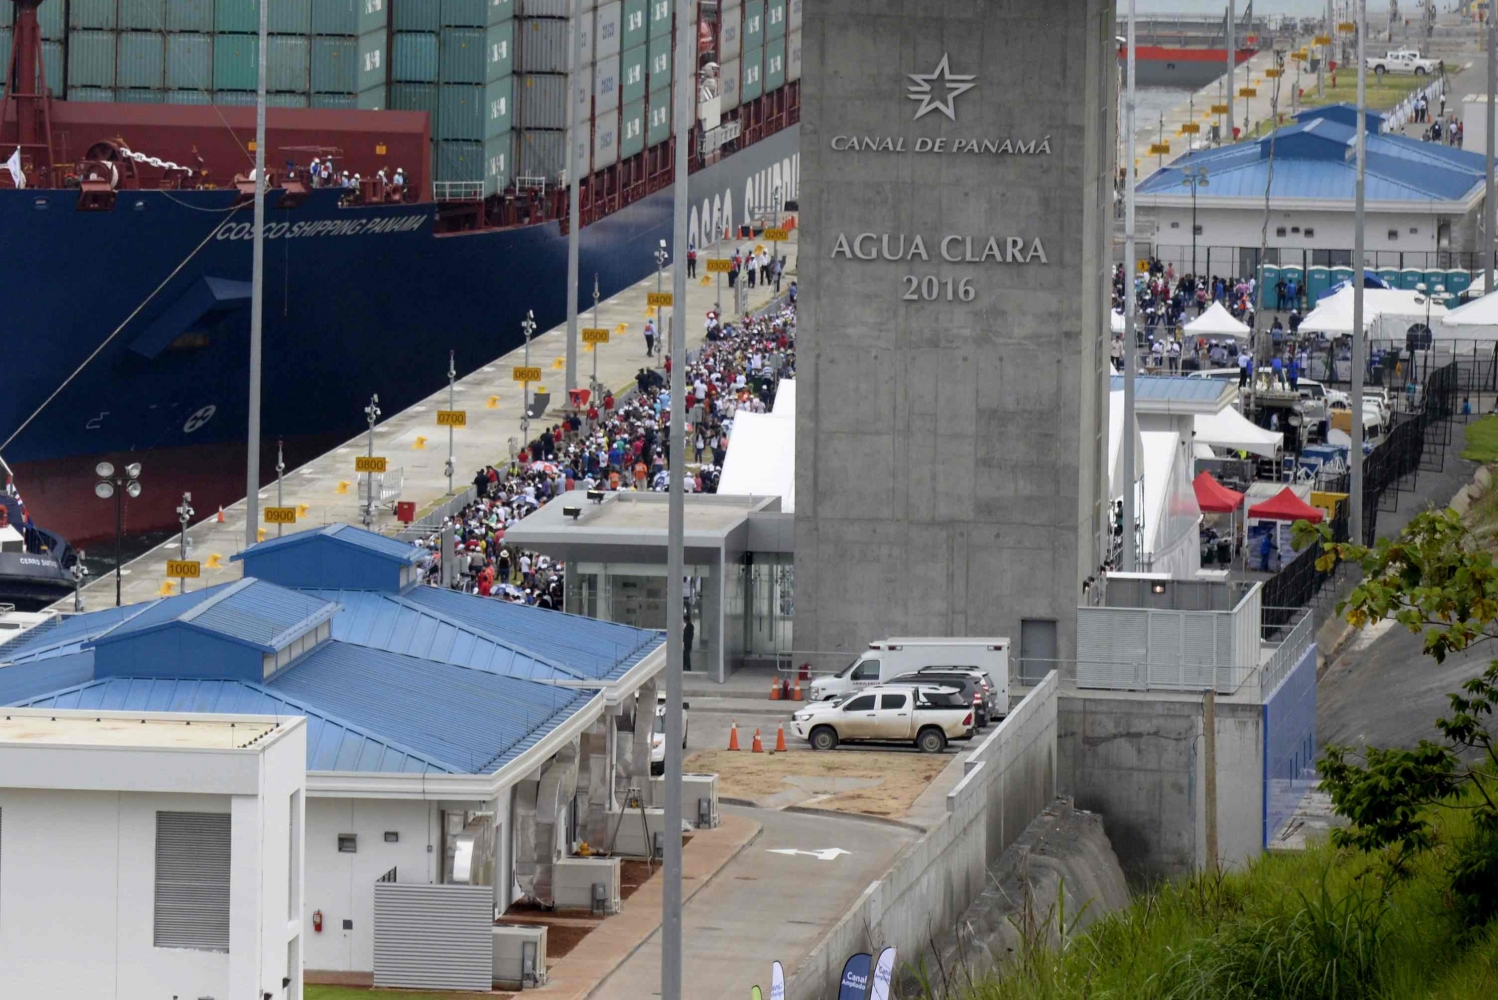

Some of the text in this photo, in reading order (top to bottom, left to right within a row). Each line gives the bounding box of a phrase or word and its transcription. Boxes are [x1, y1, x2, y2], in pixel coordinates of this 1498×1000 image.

[831, 135, 1052, 154] CANAL DE PANAMÁ
[687, 187, 733, 250] OSCO
[284, 219, 368, 239] SHIPPING
[360, 214, 428, 235] PANAMA
[764, 230, 788, 240] 0200
[831, 232, 1048, 264] AGUA CLARA
[707, 262, 731, 272] 0300
[902, 275, 976, 301] 2016
[649, 295, 672, 305] 0400
[583, 331, 608, 342] 0500
[514, 369, 540, 380] 0600
[439, 413, 464, 424] 0700
[357, 459, 384, 471] 0800
[267, 510, 295, 522] 0900
[169, 563, 197, 575] 1000
[846, 971, 868, 984] Canal
[841, 978, 867, 991] Ampliado
